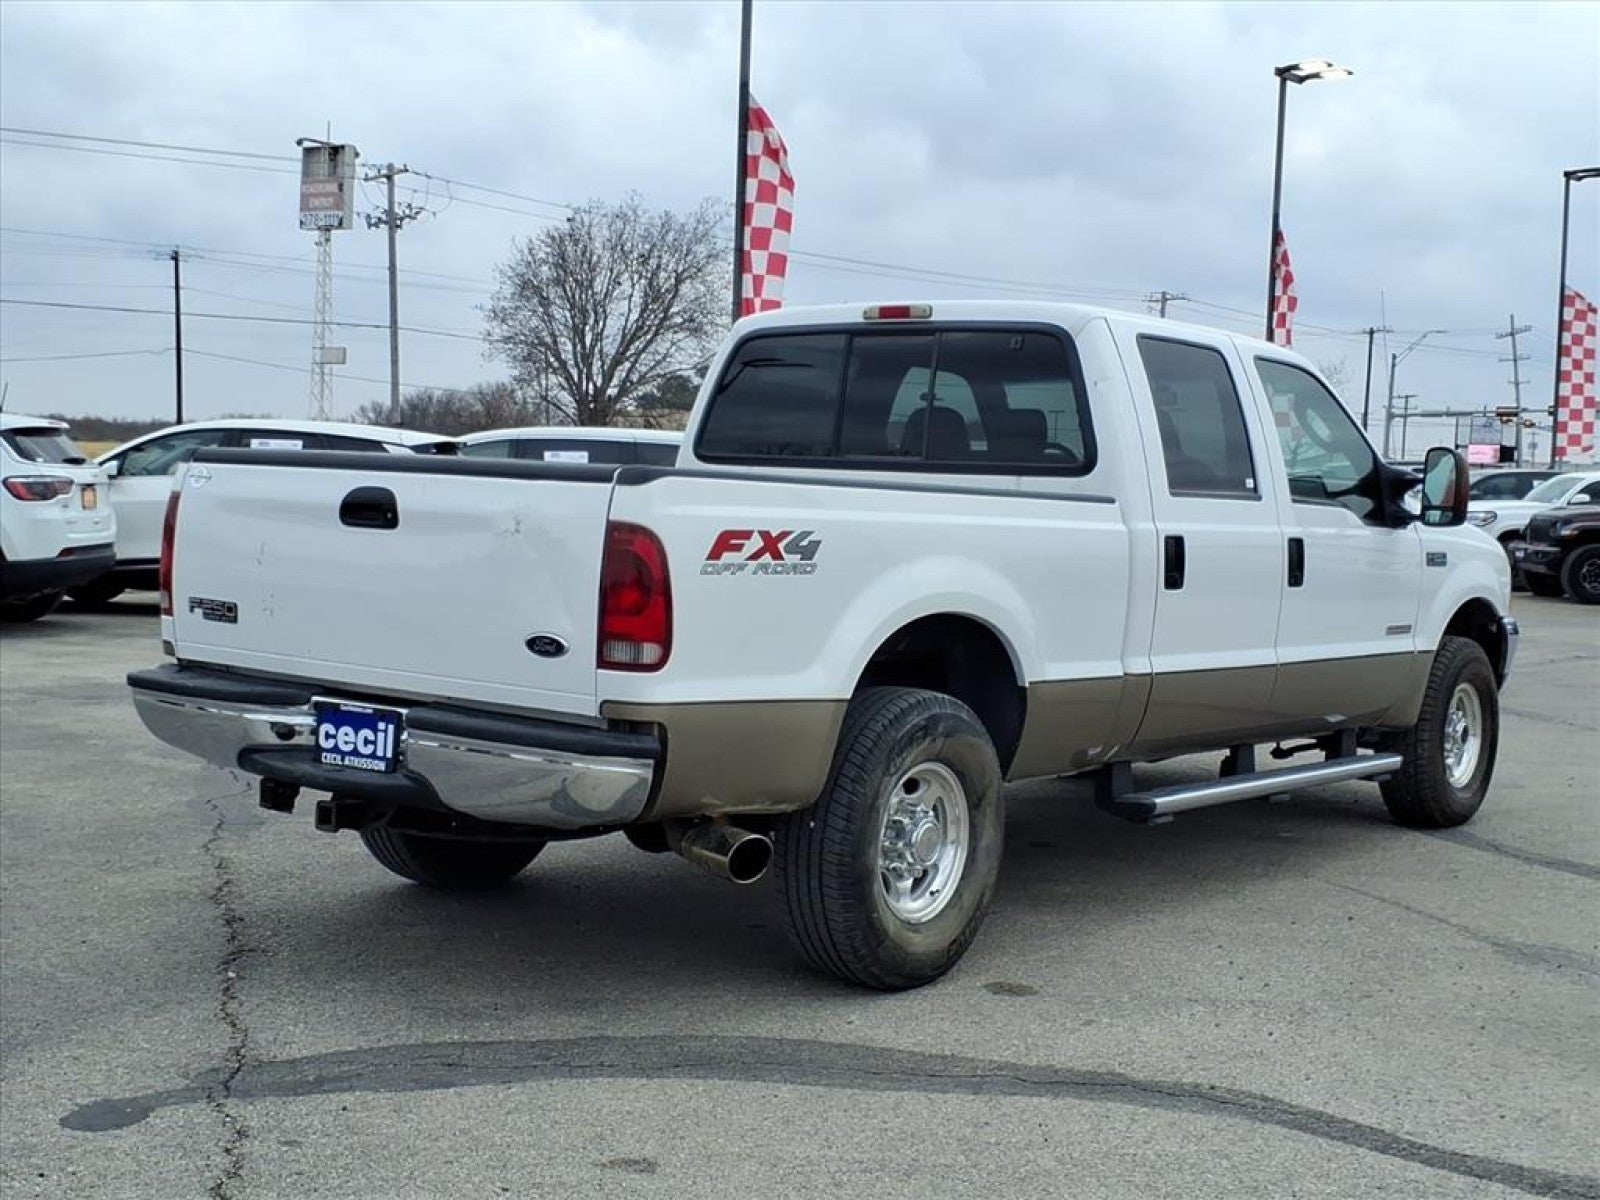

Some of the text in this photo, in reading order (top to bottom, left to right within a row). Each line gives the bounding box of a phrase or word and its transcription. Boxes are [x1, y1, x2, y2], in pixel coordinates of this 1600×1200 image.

[705, 530, 822, 561] FX4
[699, 562, 817, 575] OFF ROAD
[318, 721, 395, 759] cecil
[321, 752, 342, 765] CECIL
